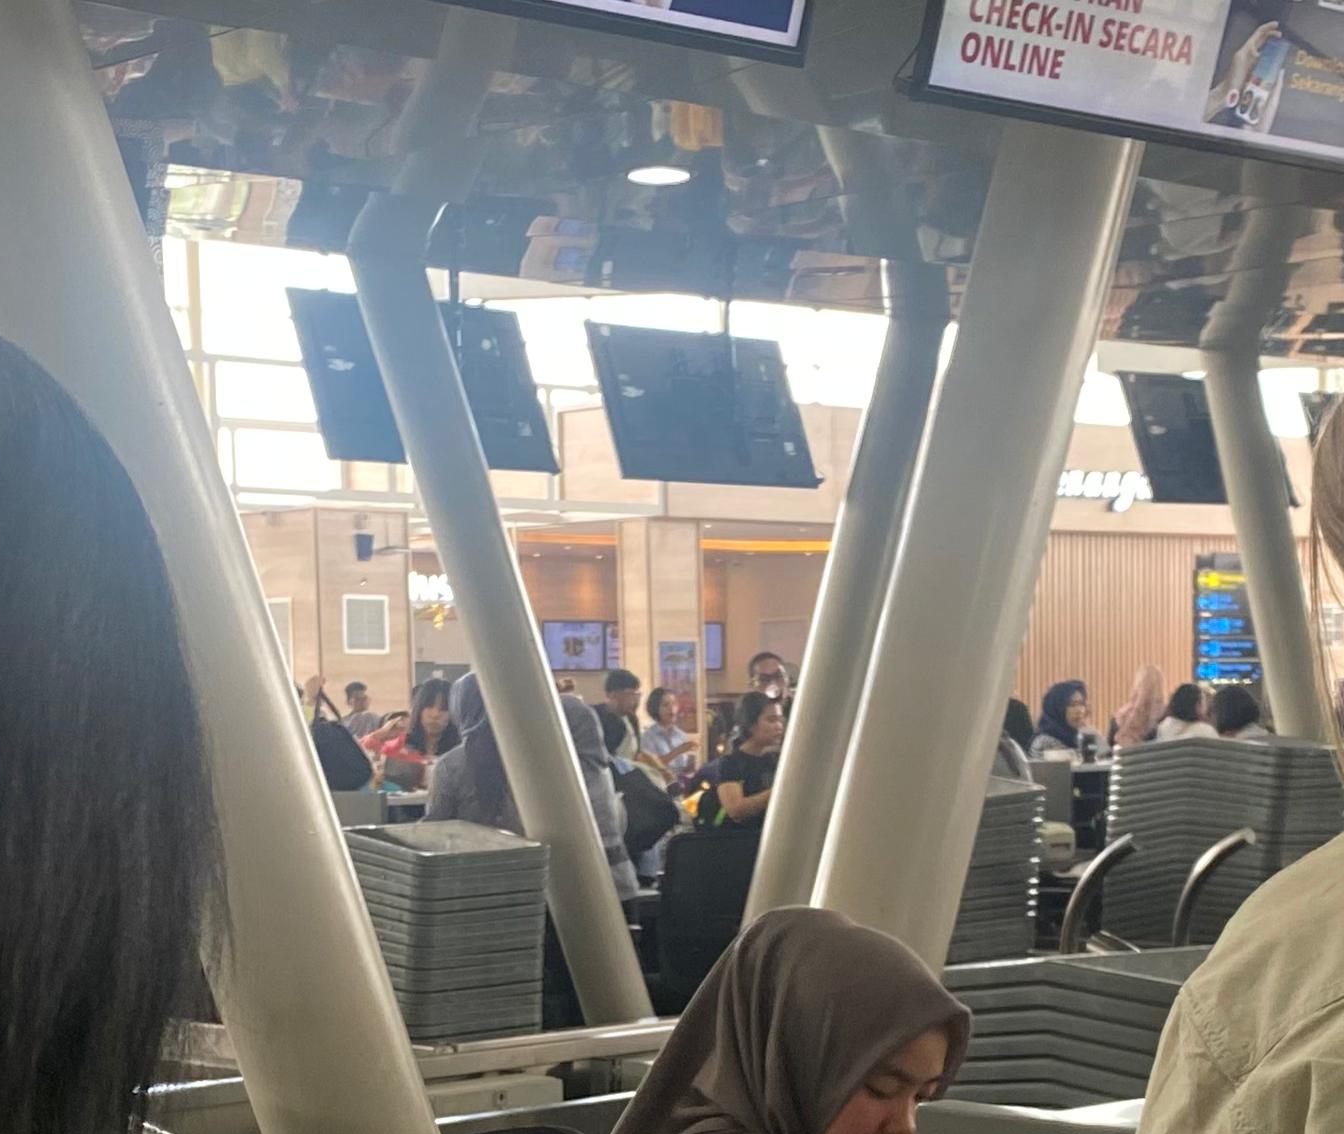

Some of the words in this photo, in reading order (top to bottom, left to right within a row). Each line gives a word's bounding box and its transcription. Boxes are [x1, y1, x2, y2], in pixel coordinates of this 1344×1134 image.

[960, 31, 1066, 80] ONLINE
[969, 0, 1095, 44] CHECK-IN
[1099, 18, 1194, 66] SECARA
